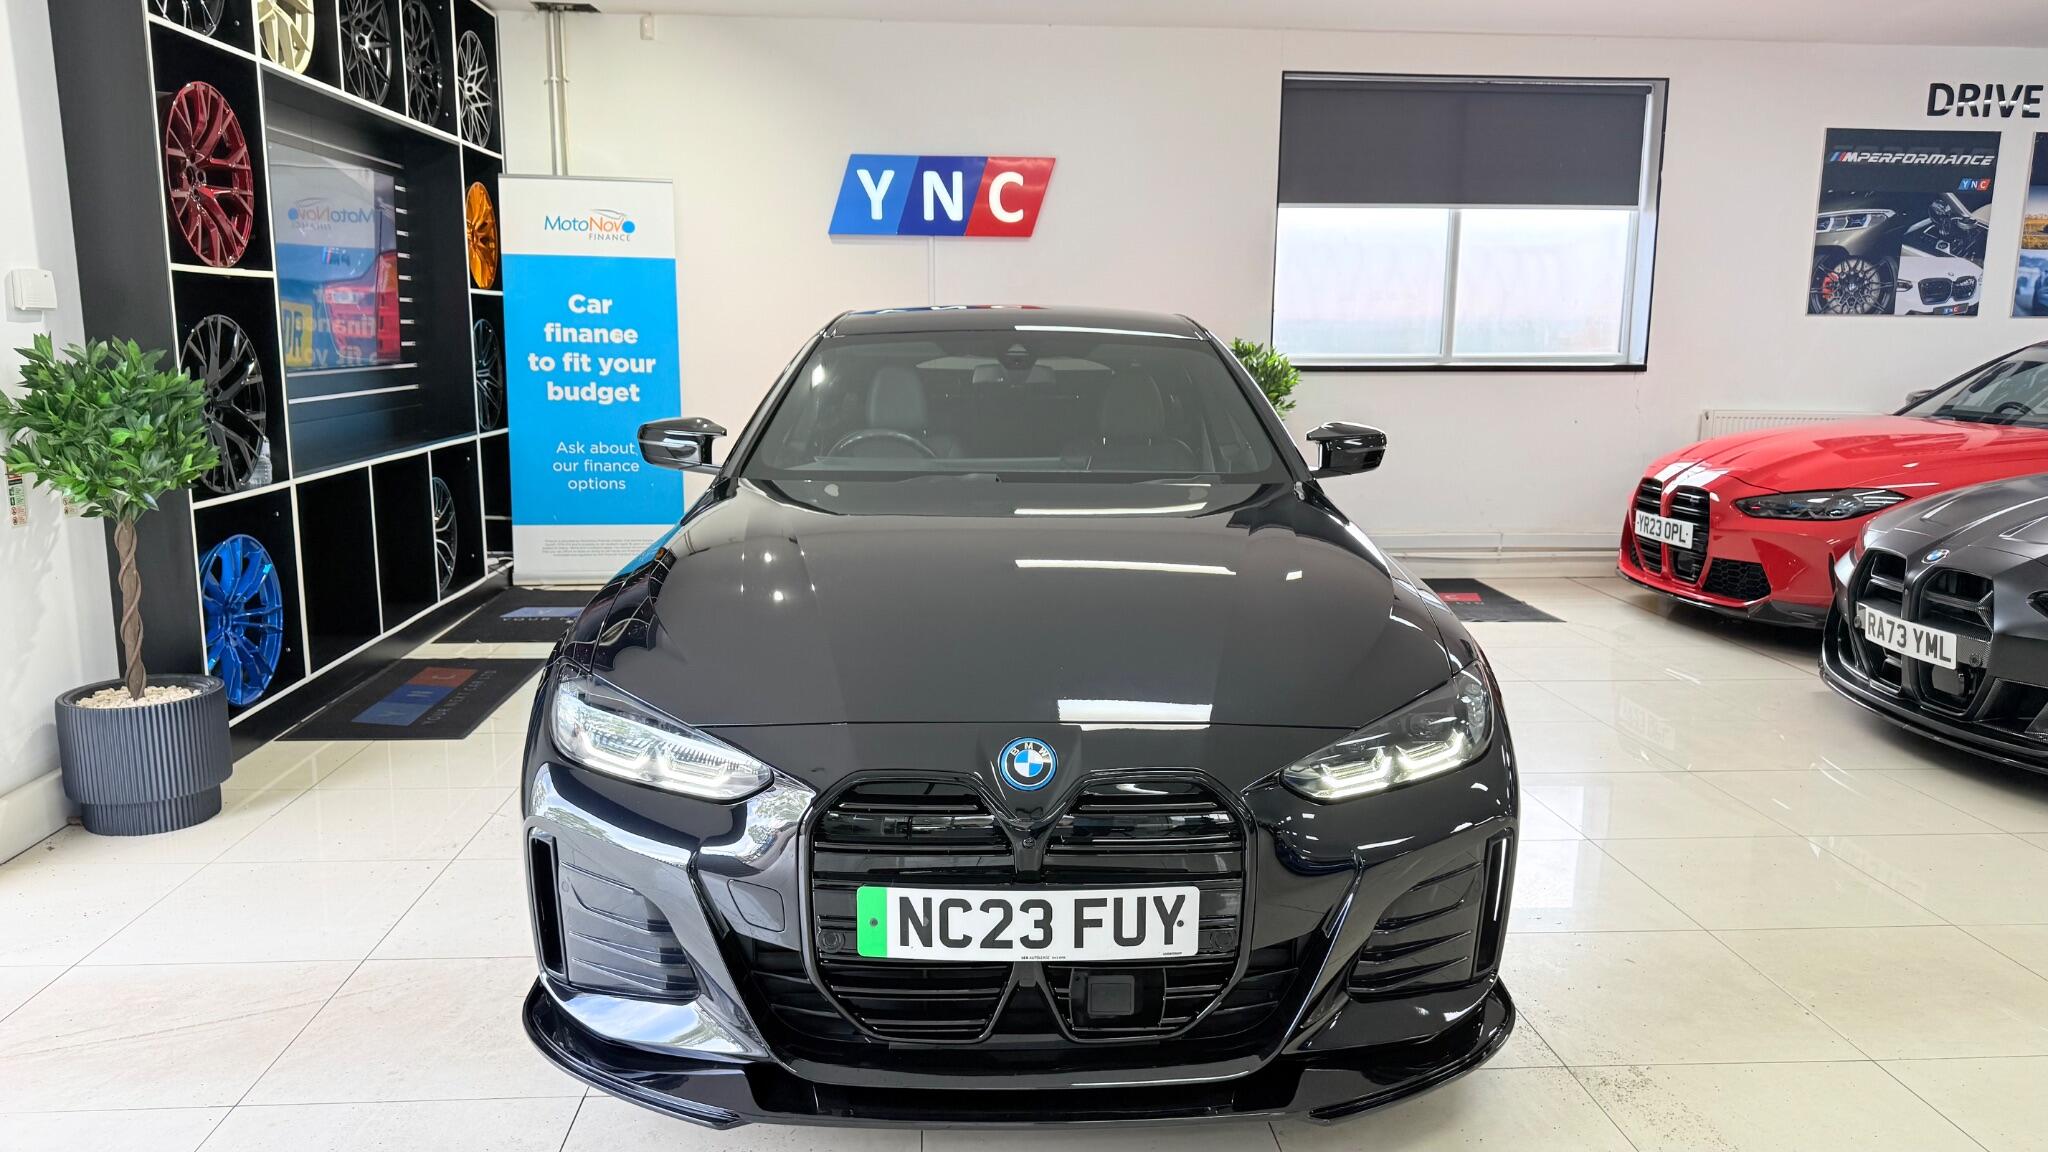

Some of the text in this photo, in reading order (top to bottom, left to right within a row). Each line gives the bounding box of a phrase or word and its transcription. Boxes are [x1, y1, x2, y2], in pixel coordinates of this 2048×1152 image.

[1927, 82, 2044, 118] DRIVE
[1961, 179, 1990, 190] YNC
[856, 169, 1025, 224] YNC
[588, 233, 632, 242] FINANCE
[568, 294, 613, 314] Car
[544, 323, 639, 344] finance
[528, 352, 656, 378] to fit your
[547, 381, 640, 406] budget
[556, 440, 635, 455] Ask about
[553, 459, 640, 473] our finance
[567, 477, 626, 492] options
[1638, 514, 1662, 537] YR23
[1867, 611, 1952, 664] RA73 YML
[1010, 742, 1049, 757] BMW
[898, 895, 1187, 950] NC23 FUY
